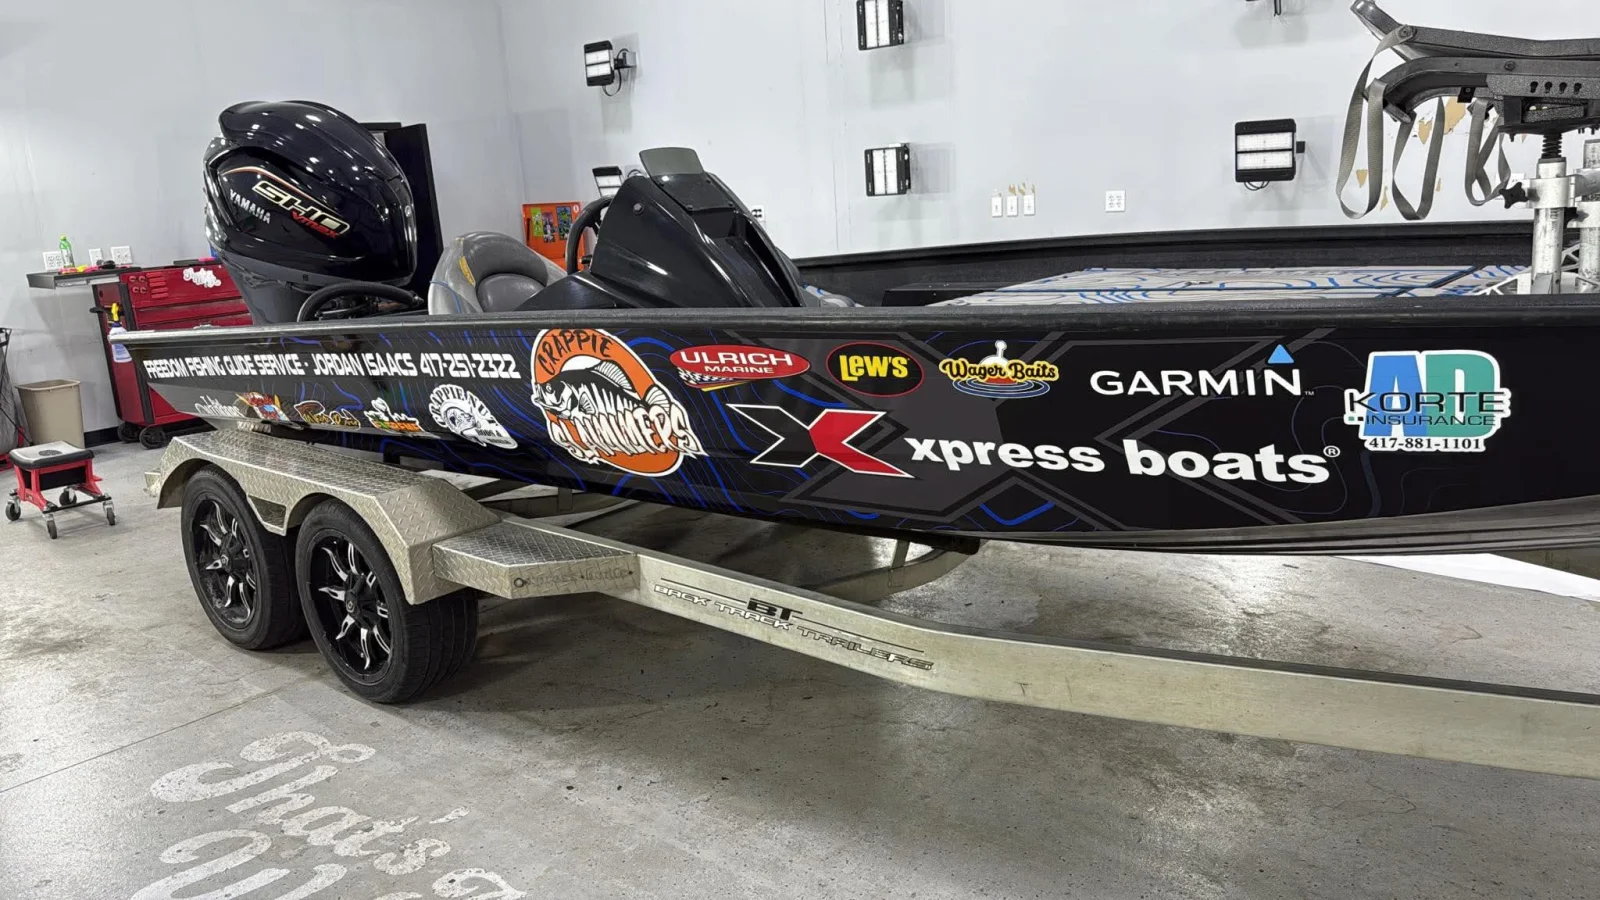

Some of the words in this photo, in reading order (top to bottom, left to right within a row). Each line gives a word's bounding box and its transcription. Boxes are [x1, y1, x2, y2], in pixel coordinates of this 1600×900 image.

[230, 189, 271, 224] YAMAHA
[252, 180, 350, 235] SHO
[142, 358, 189, 378] FREEDOM
[185, 356, 225, 376] FISHING
[223, 354, 257, 375] GUIDE
[254, 353, 305, 376] SERVICE
[311, 353, 365, 376] JORDAN
[361, 353, 418, 376] ISAACS
[420, 353, 521, 379] 417-251-2322
[537, 329, 614, 376] CRAPPIE
[680, 351, 793, 366] ULRICH
[704, 365, 775, 374] MARINE
[942, 359, 1006, 379] Wager
[1008, 361, 1058, 379] Baits
[1090, 369, 1301, 396] GARMIN
[431, 386, 465, 426] CRAPPIE
[1349, 392, 1505, 412] KORTE
[551, 403, 703, 461] SLAMMERS
[1366, 415, 1496, 426] INSURANCE
[904, 437, 1105, 475] xpress
[1369, 437, 1481, 450] 417-881-1101
[654, 584, 711, 606] BACK
[714, 602, 794, 631] TRACK
[797, 625, 935, 671] TRAILERS
